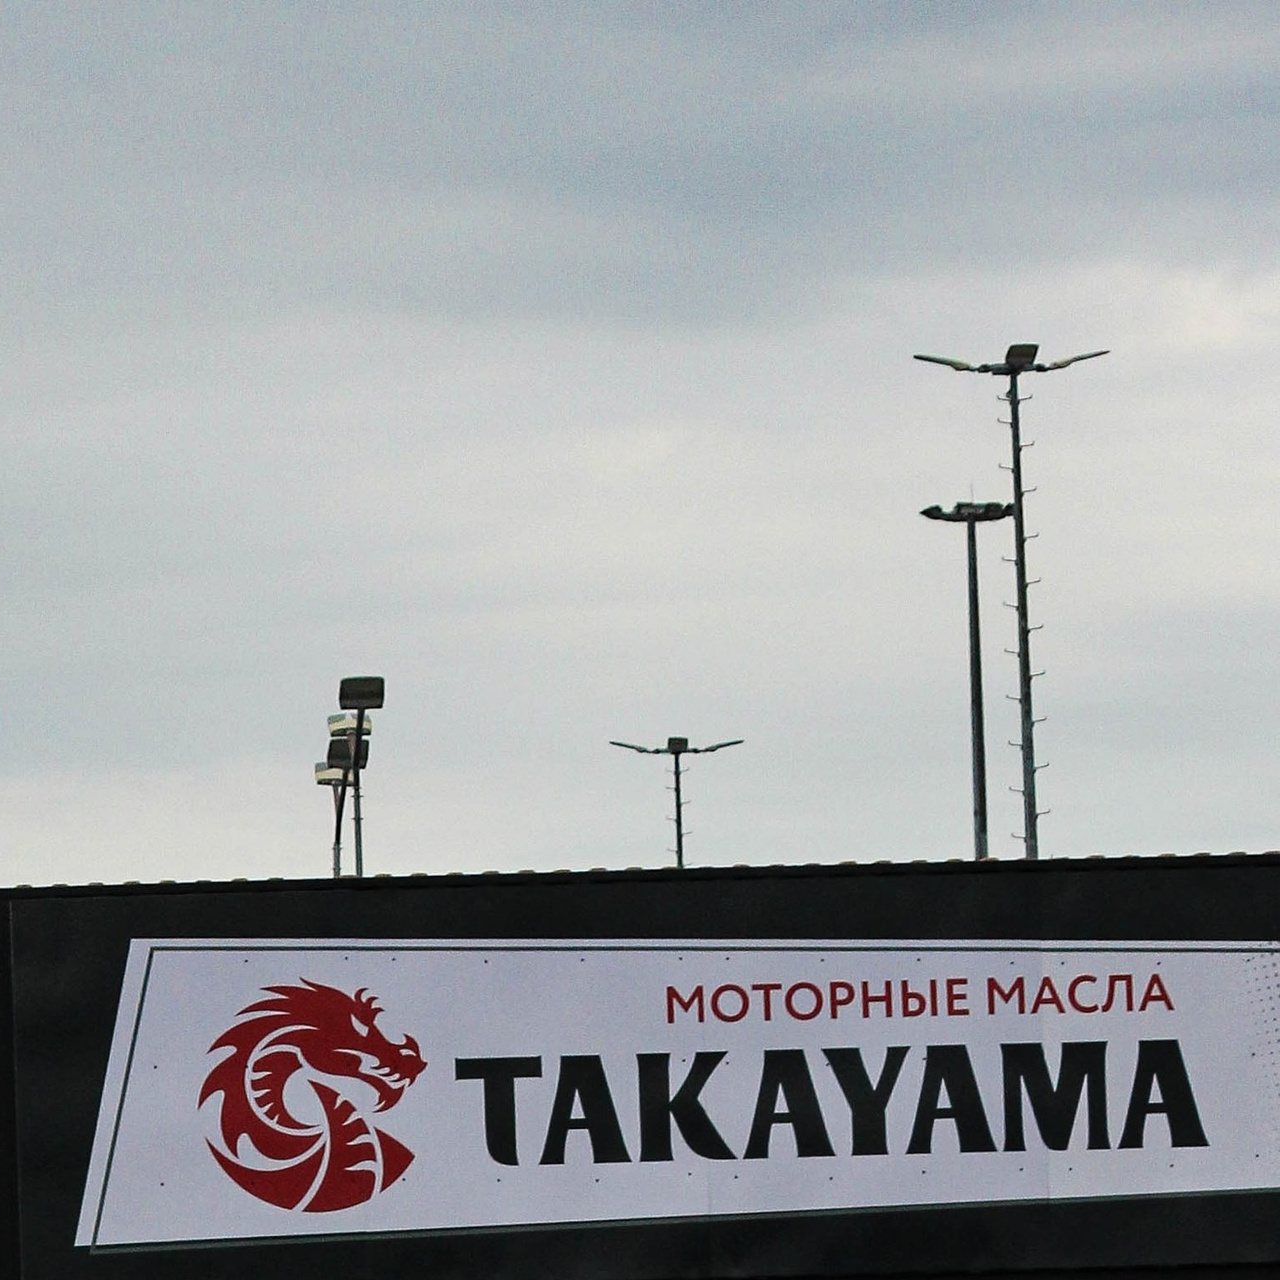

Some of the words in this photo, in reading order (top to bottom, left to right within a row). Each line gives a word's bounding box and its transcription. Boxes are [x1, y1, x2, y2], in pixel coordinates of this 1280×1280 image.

[666, 978, 970, 1024] МОТОРНЫЕ
[987, 972, 1175, 1016] МАСЛА
[454, 1038, 1211, 1167] TAKAYAMA
